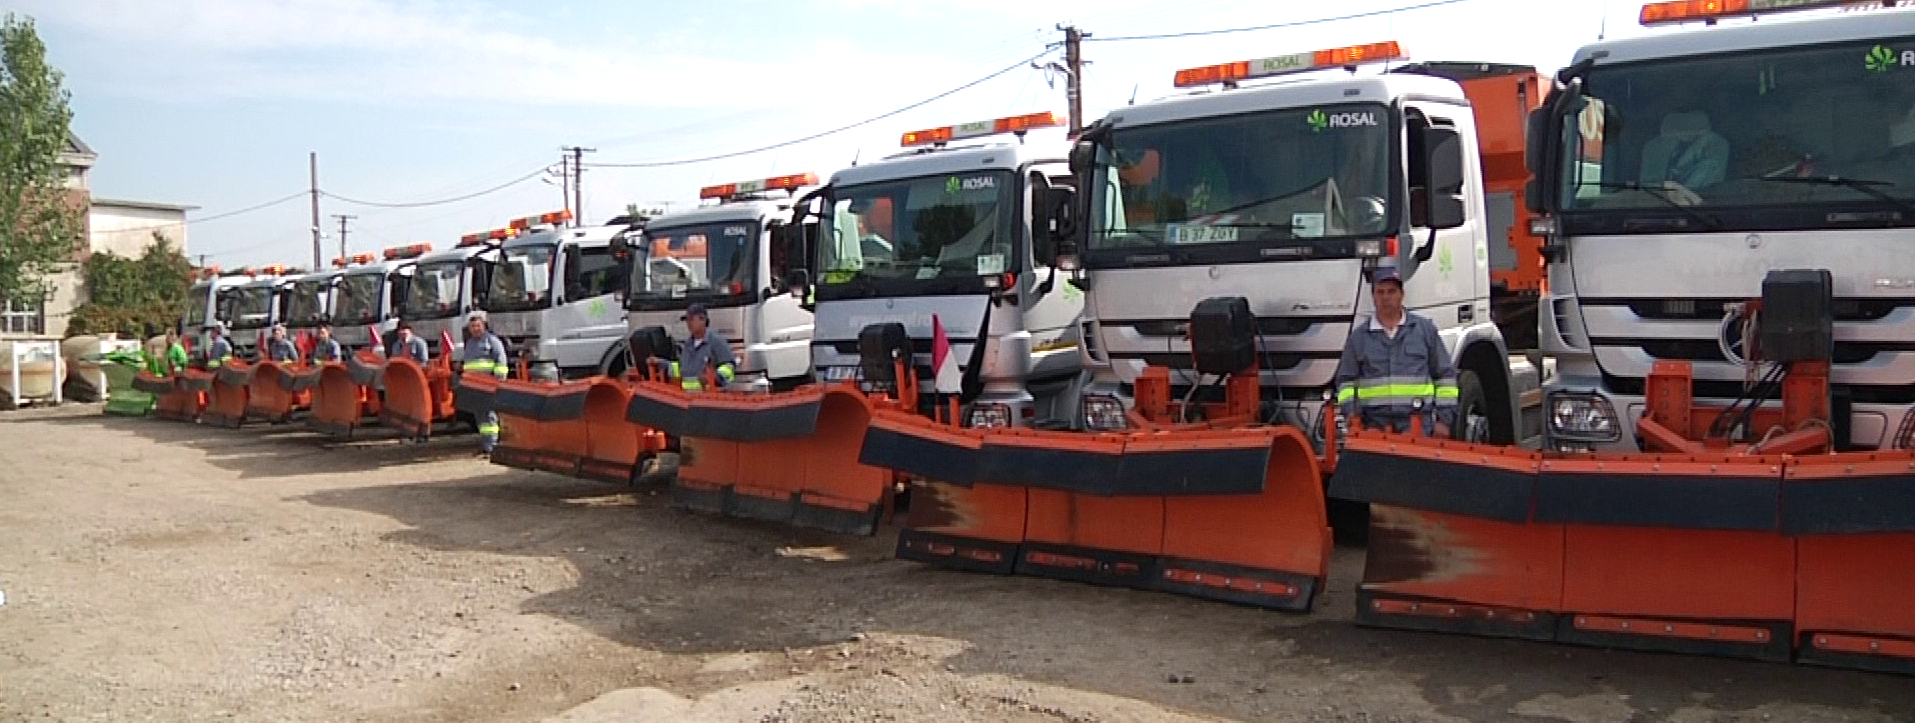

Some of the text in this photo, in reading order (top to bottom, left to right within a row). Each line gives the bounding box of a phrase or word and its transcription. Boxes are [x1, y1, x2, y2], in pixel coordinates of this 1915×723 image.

[1263, 54, 1301, 70] ROSAL
[1329, 112, 1378, 128] ROSAL
[962, 176, 995, 190] ROSAL
